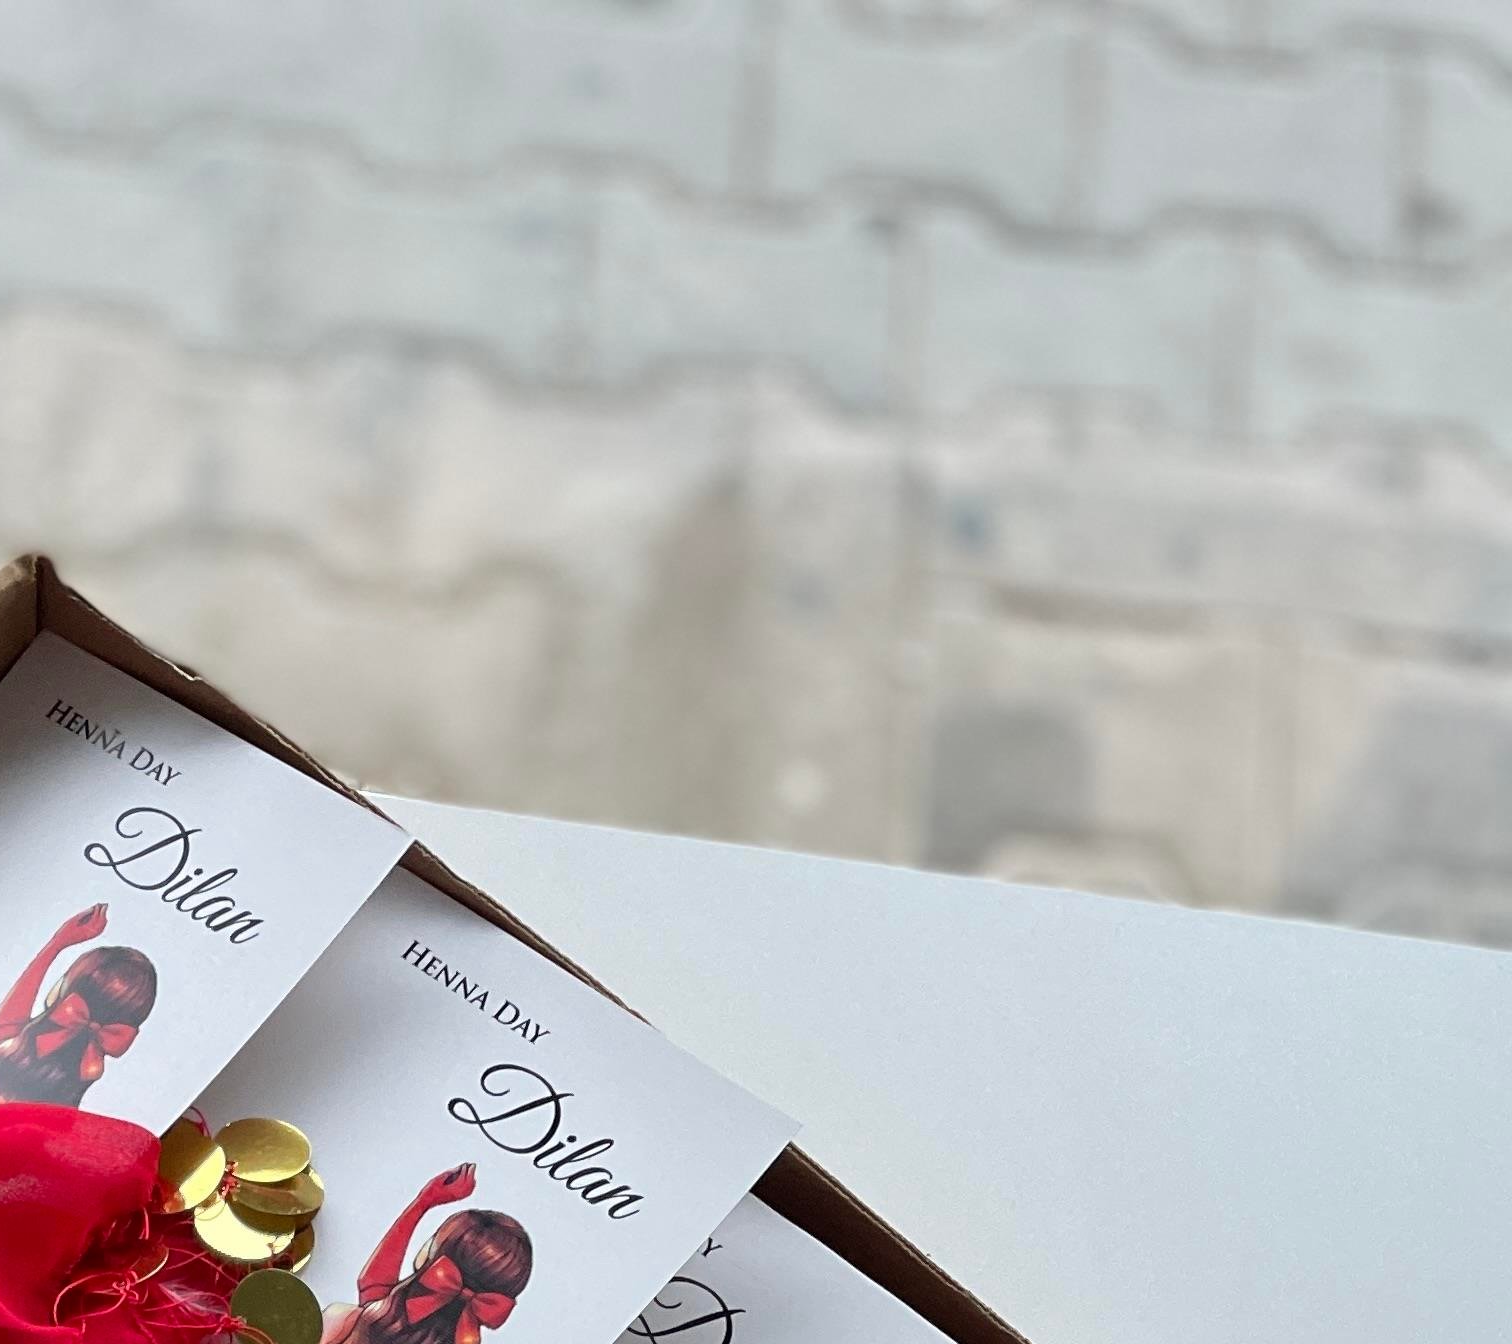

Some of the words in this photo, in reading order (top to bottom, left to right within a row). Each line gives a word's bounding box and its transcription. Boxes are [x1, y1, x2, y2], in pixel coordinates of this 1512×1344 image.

[45, 700, 127, 760] HENNA
[128, 746, 183, 786] DAY
[84, 807, 264, 944] Dilan
[401, 940, 489, 1011] HENNA
[492, 1000, 551, 1045] DAY
[447, 1063, 644, 1220] Dilan
